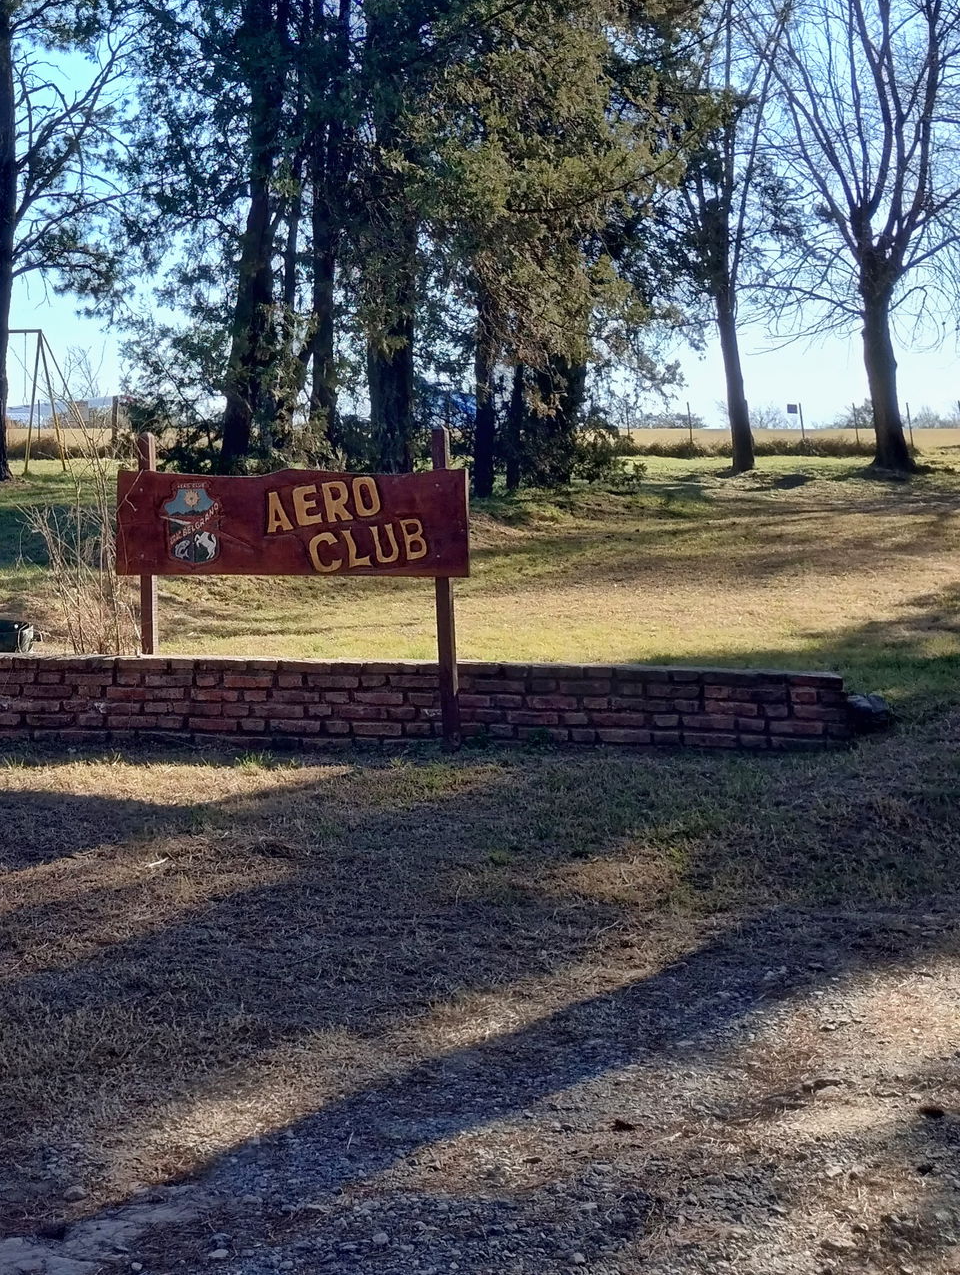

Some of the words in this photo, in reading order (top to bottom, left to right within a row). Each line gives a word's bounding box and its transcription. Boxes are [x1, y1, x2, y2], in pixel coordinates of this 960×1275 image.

[182, 502, 219, 536] BELGRANO
[267, 476, 381, 533] AERO
[309, 518, 427, 573] CLUB
